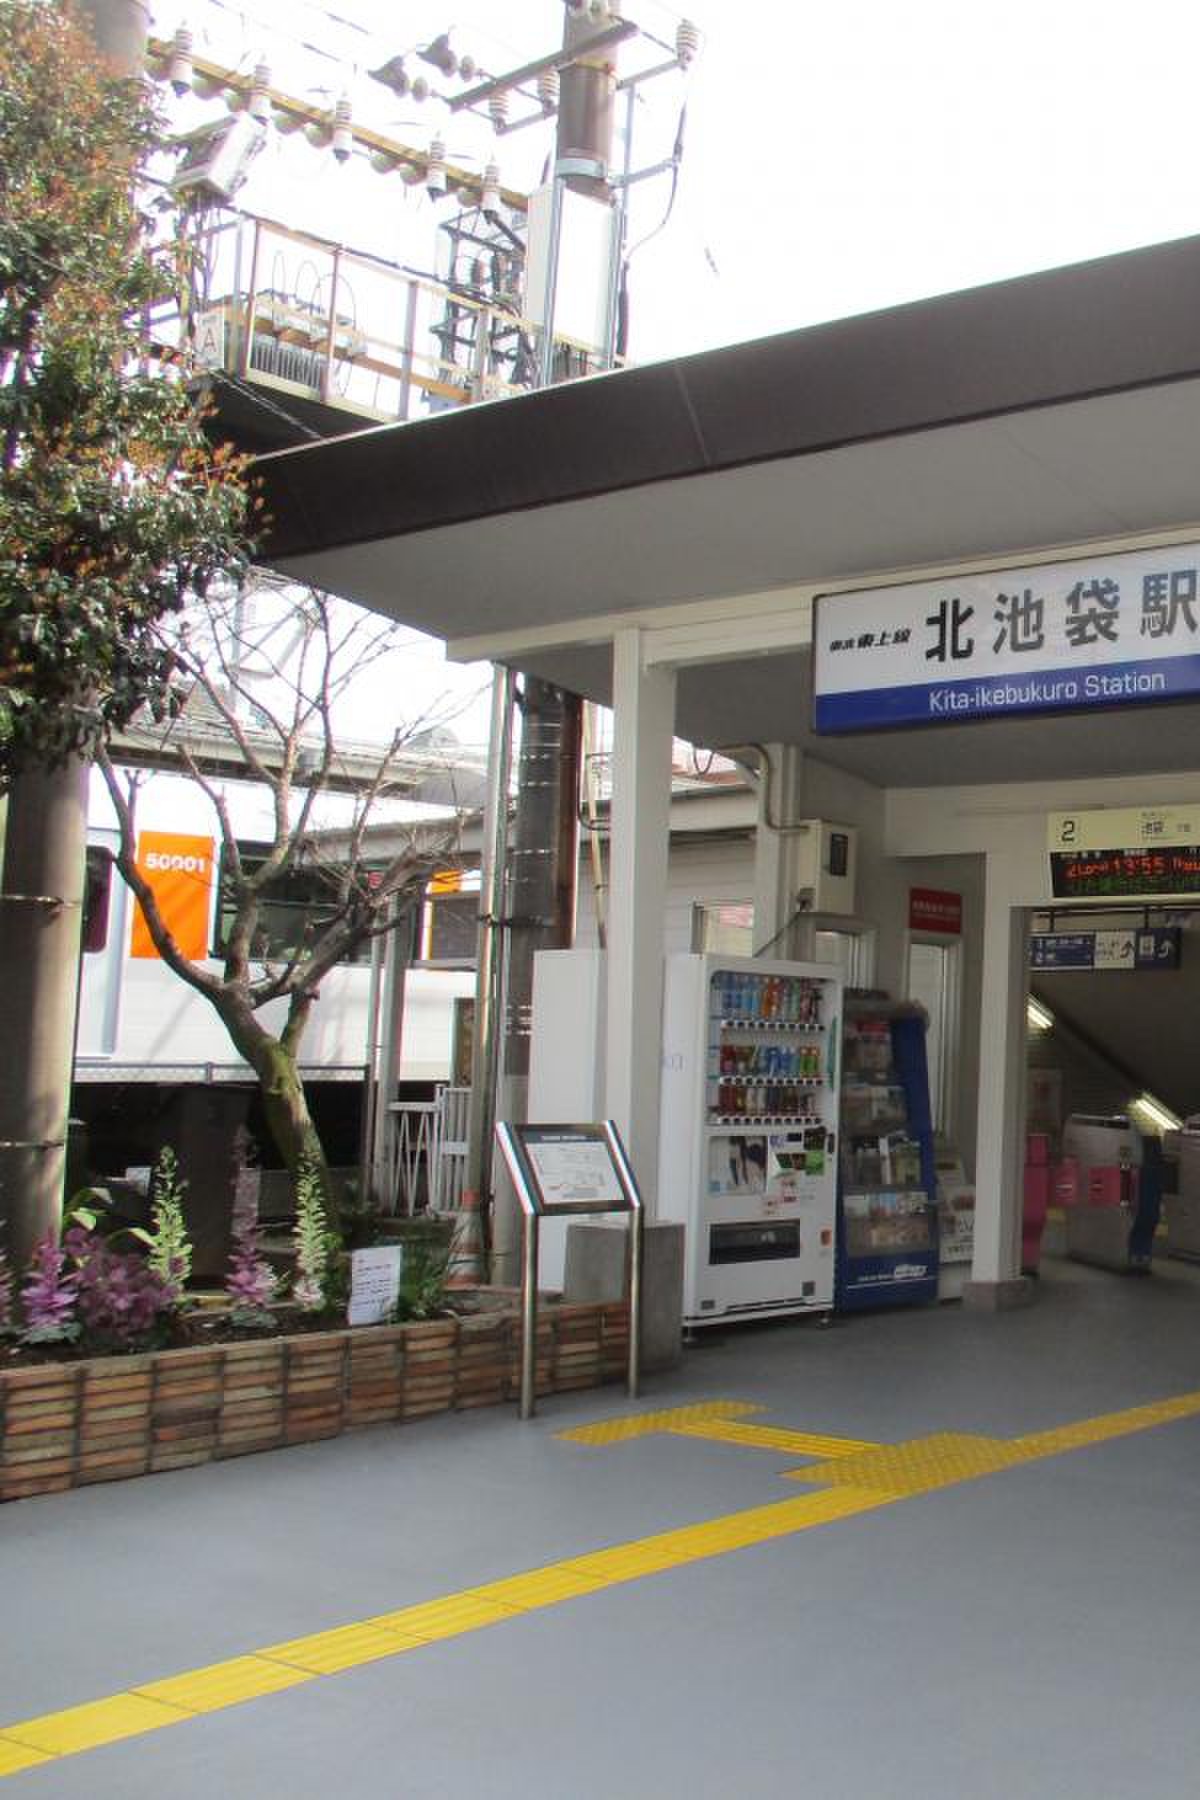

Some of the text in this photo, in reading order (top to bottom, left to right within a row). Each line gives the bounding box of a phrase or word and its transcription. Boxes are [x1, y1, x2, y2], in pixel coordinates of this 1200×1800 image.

[925, 569, 1199, 663] 北池袋駅
[1085, 671, 1166, 695] Station
[1061, 820, 1075, 842] 2
[146, 851, 206, 873] 50001
